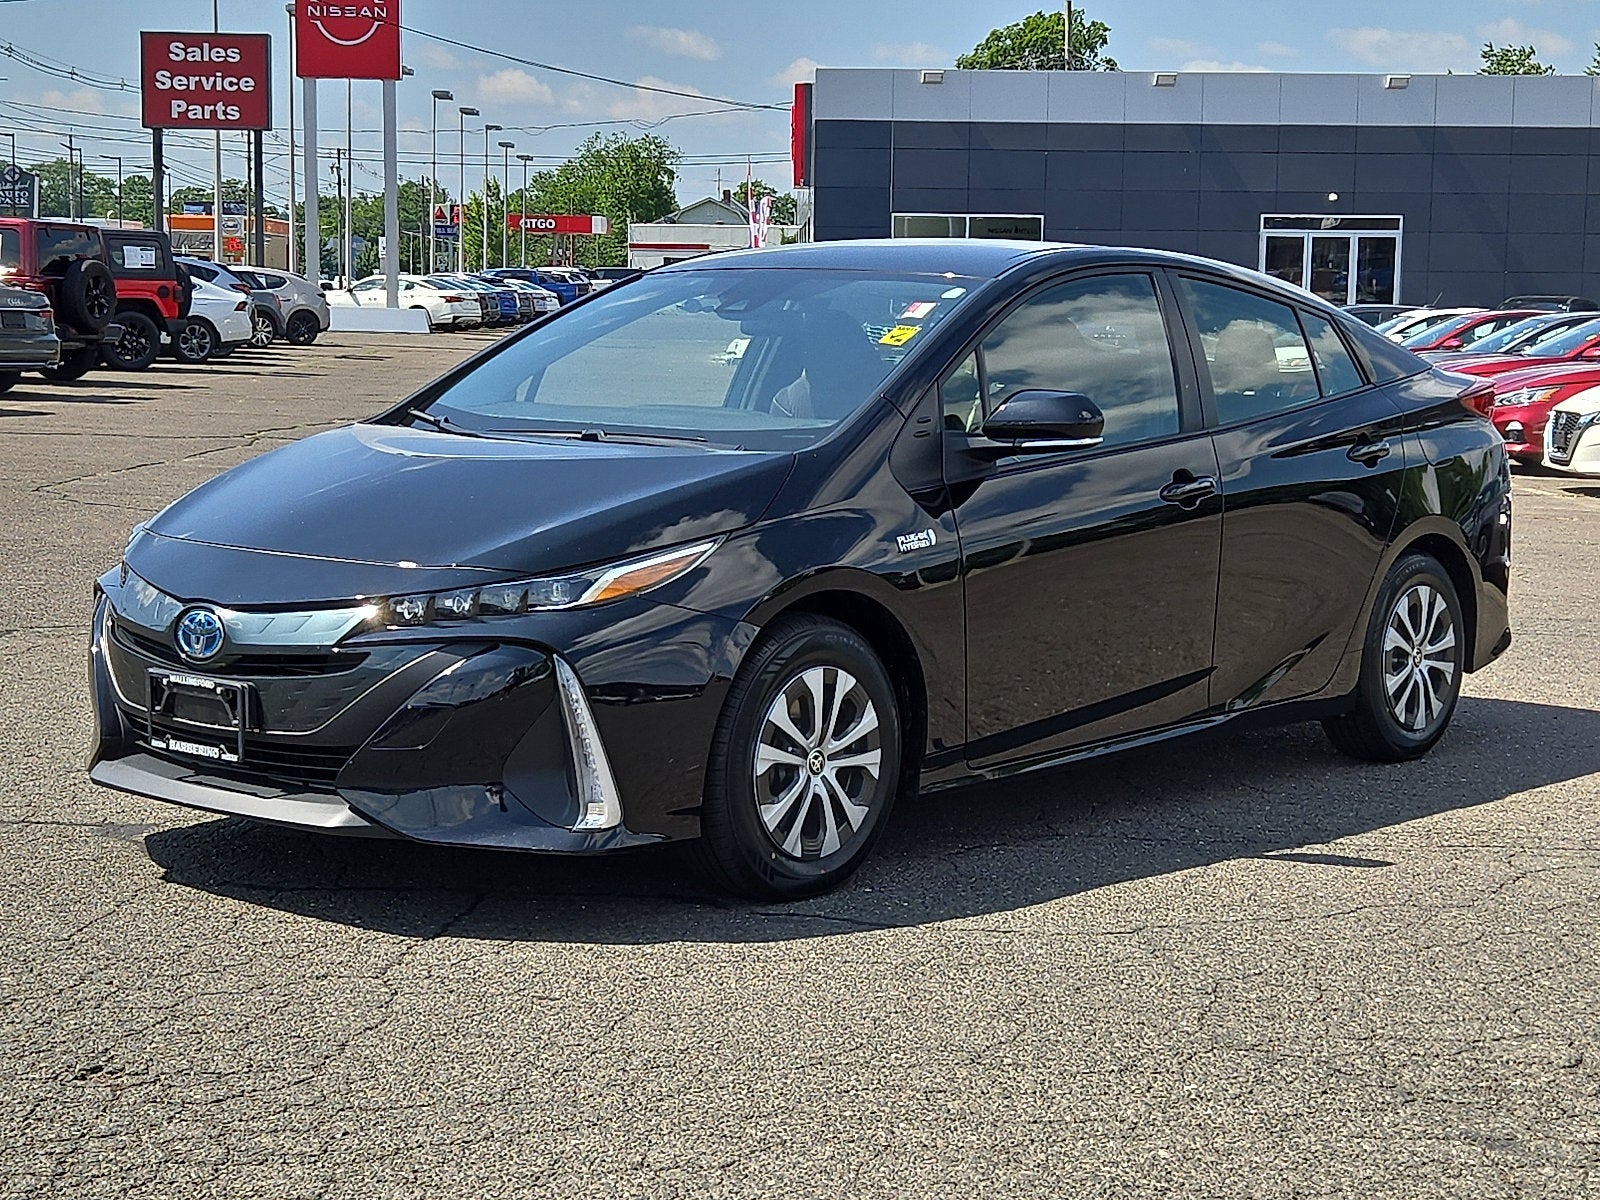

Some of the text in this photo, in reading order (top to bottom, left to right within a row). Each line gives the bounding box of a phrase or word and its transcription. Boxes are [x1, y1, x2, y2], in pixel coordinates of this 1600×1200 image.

[307, 5, 387, 18] NISSAN
[168, 41, 241, 63] Sales
[154, 70, 255, 92] Service
[171, 99, 241, 120] Parts
